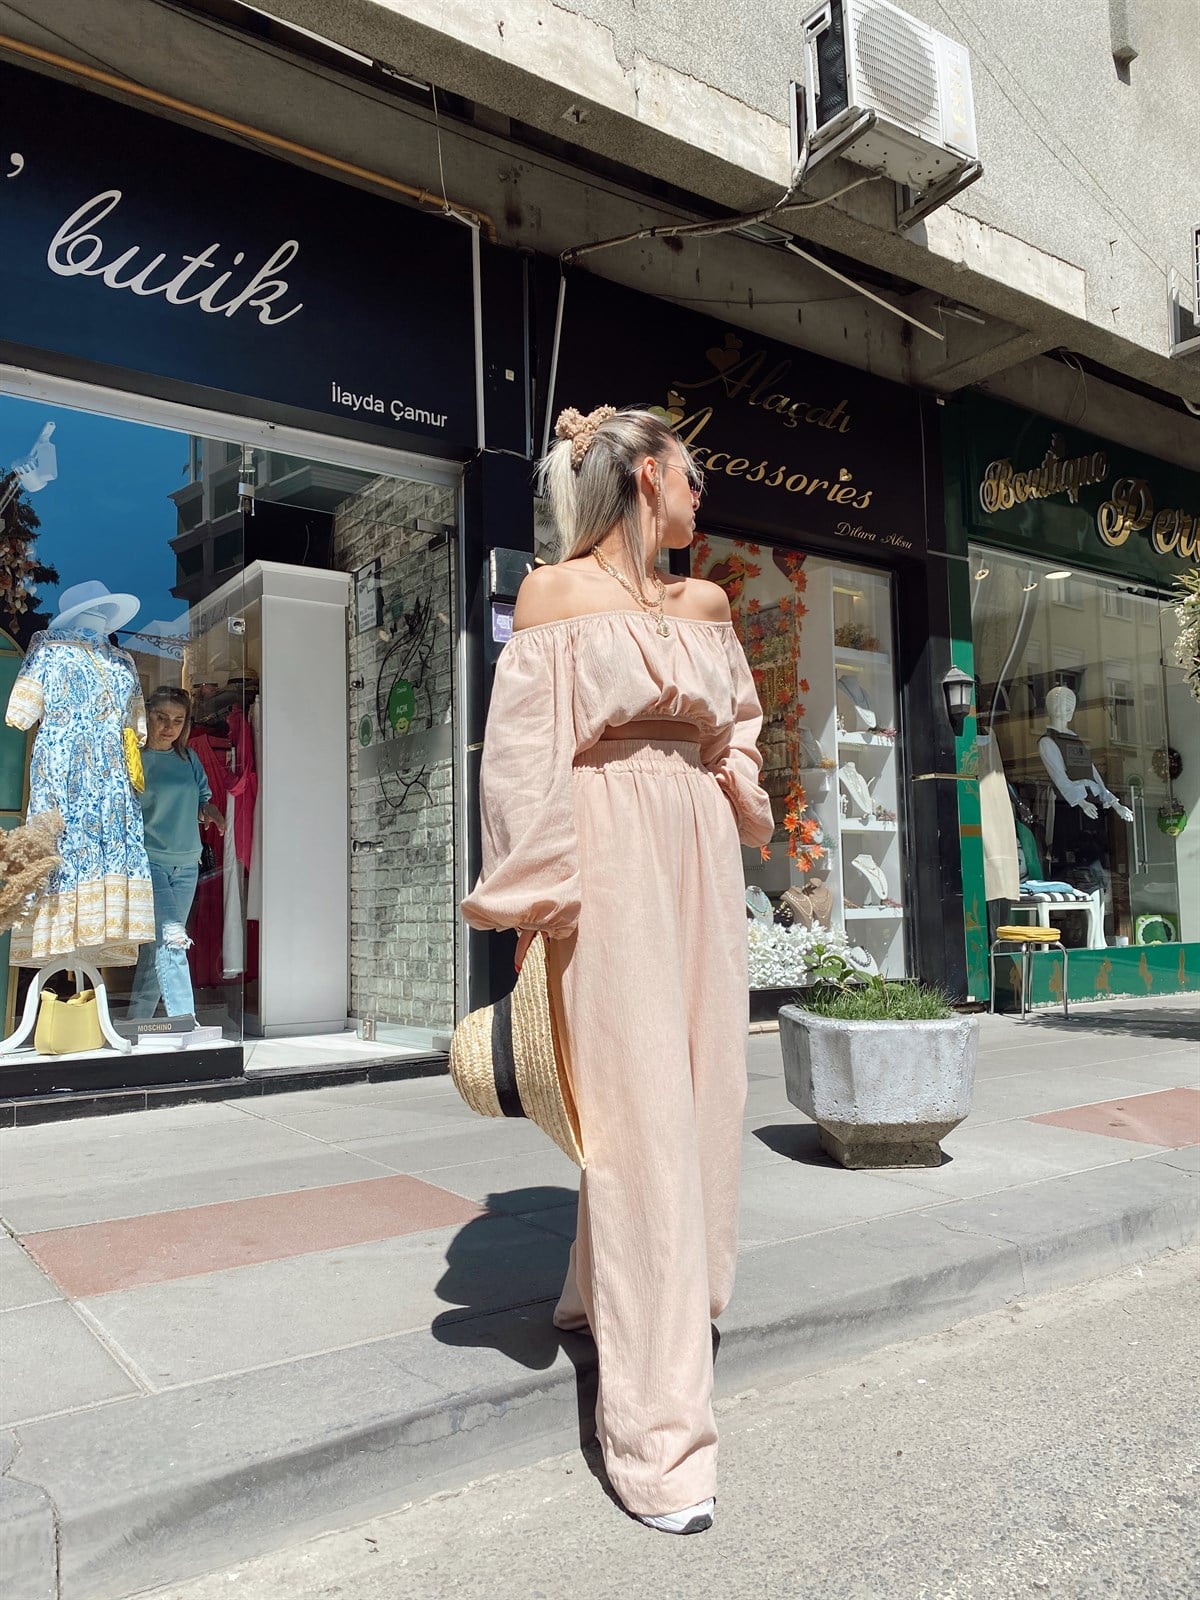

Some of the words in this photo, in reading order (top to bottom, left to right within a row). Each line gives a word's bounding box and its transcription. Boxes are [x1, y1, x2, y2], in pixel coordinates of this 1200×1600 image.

[46, 189, 304, 326] butik
[331, 381, 385, 413] İlayda
[390, 400, 448, 428] Çamur
[979, 432, 1109, 513] Boutique
[834, 521, 877, 542] Dilara
[880, 533, 913, 550] Aksu
[137, 1023, 172, 1032] MOSCHINO
